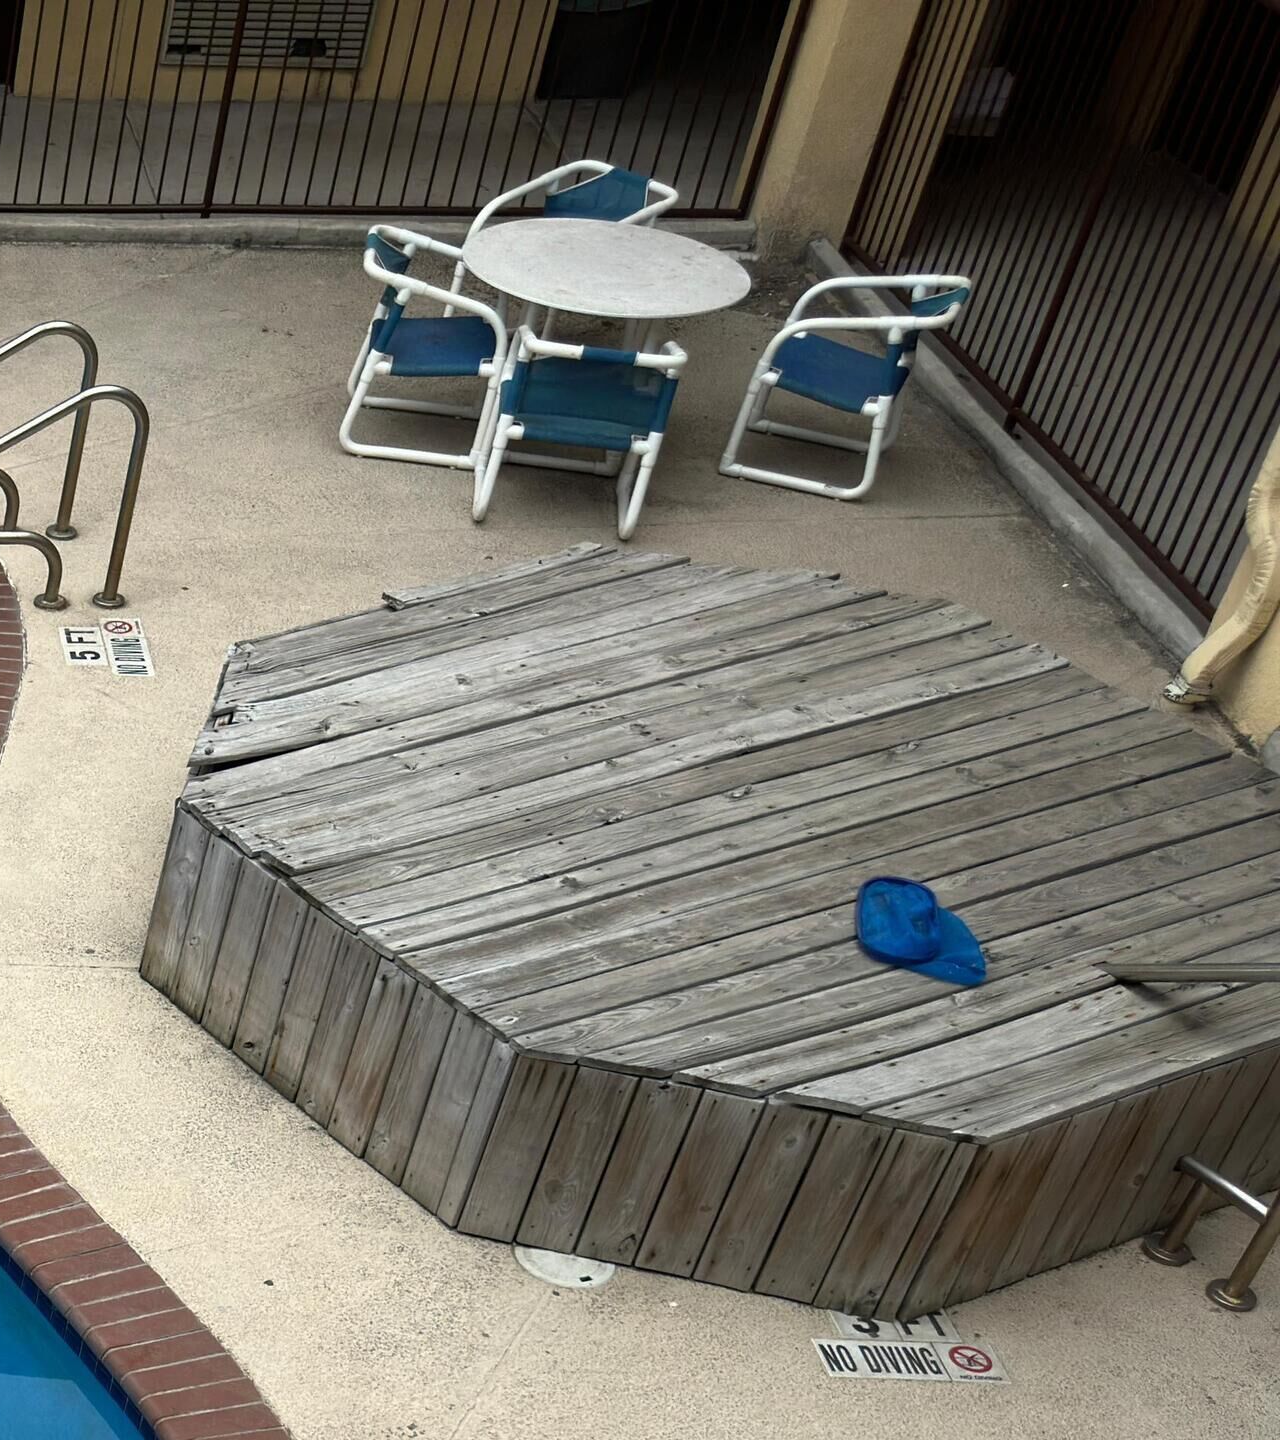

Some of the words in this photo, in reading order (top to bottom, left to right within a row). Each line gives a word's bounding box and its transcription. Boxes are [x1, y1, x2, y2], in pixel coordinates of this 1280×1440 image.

[65, 628, 97, 644] FT
[69, 650, 101, 661] 5
[110, 638, 146, 662] DIVING
[116, 664, 148, 675] NO
[819, 1343, 858, 1373] NO
[858, 1344, 944, 1375] DIVING
